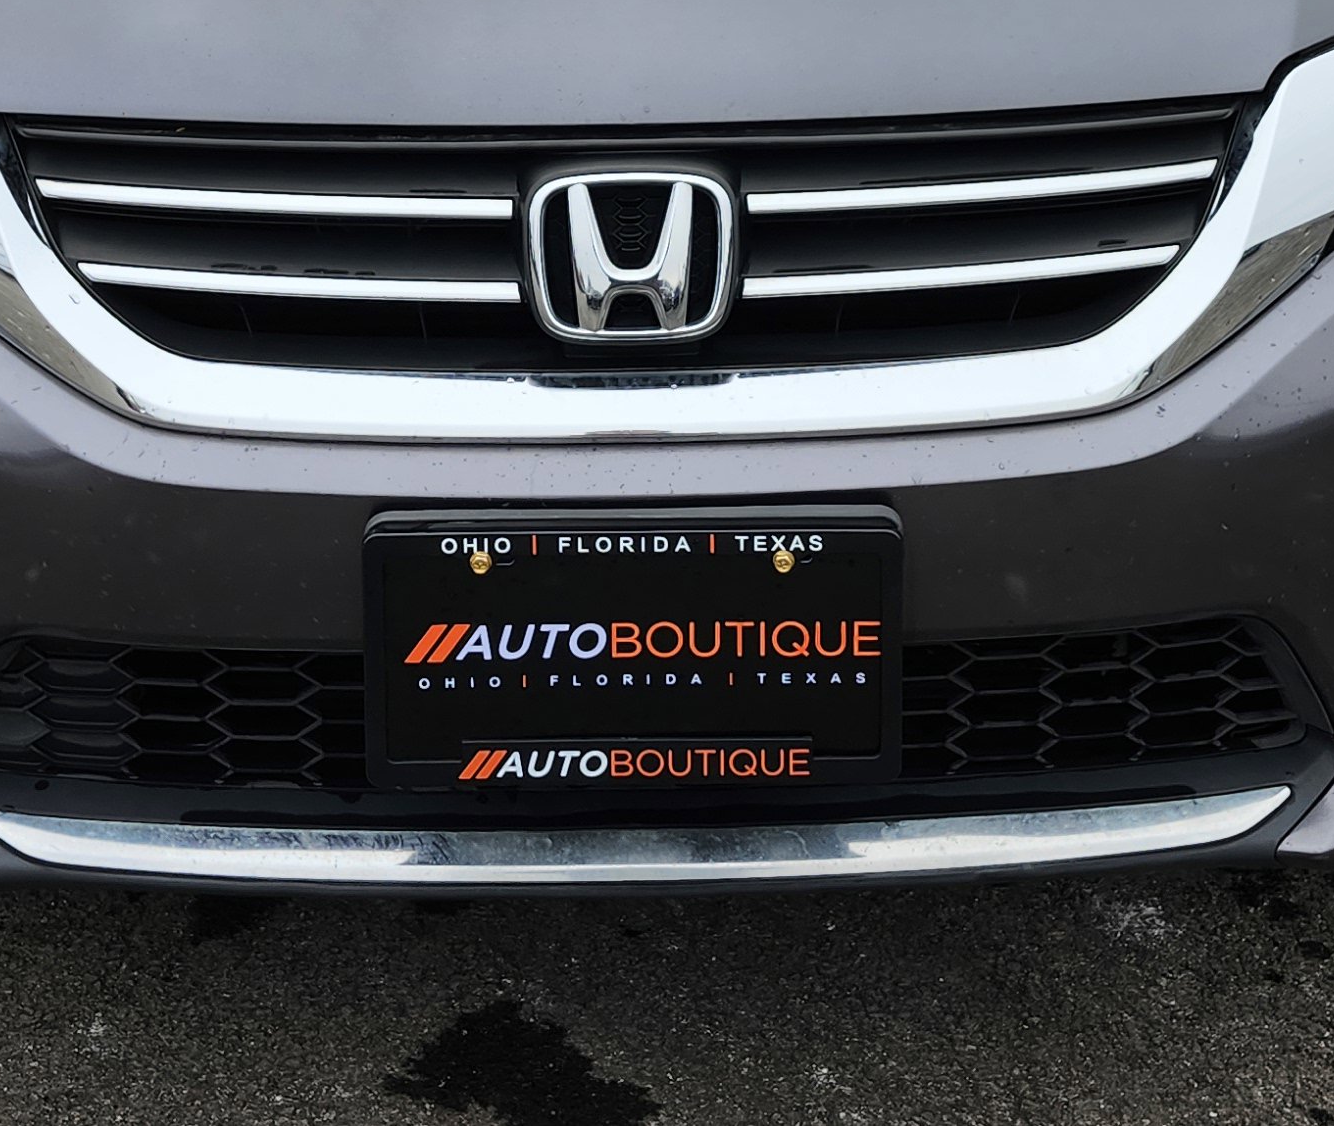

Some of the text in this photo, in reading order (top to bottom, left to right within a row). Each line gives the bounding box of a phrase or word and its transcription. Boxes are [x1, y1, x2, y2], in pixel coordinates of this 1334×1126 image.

[440, 534, 824, 555] OHIO FLORIDA TEXAS
[455, 620, 881, 661] AUTOBOUTIQUE
[418, 671, 866, 690] OHIO FLORIDA TEXAS
[496, 748, 810, 778] AUTOBOUTIQUE
